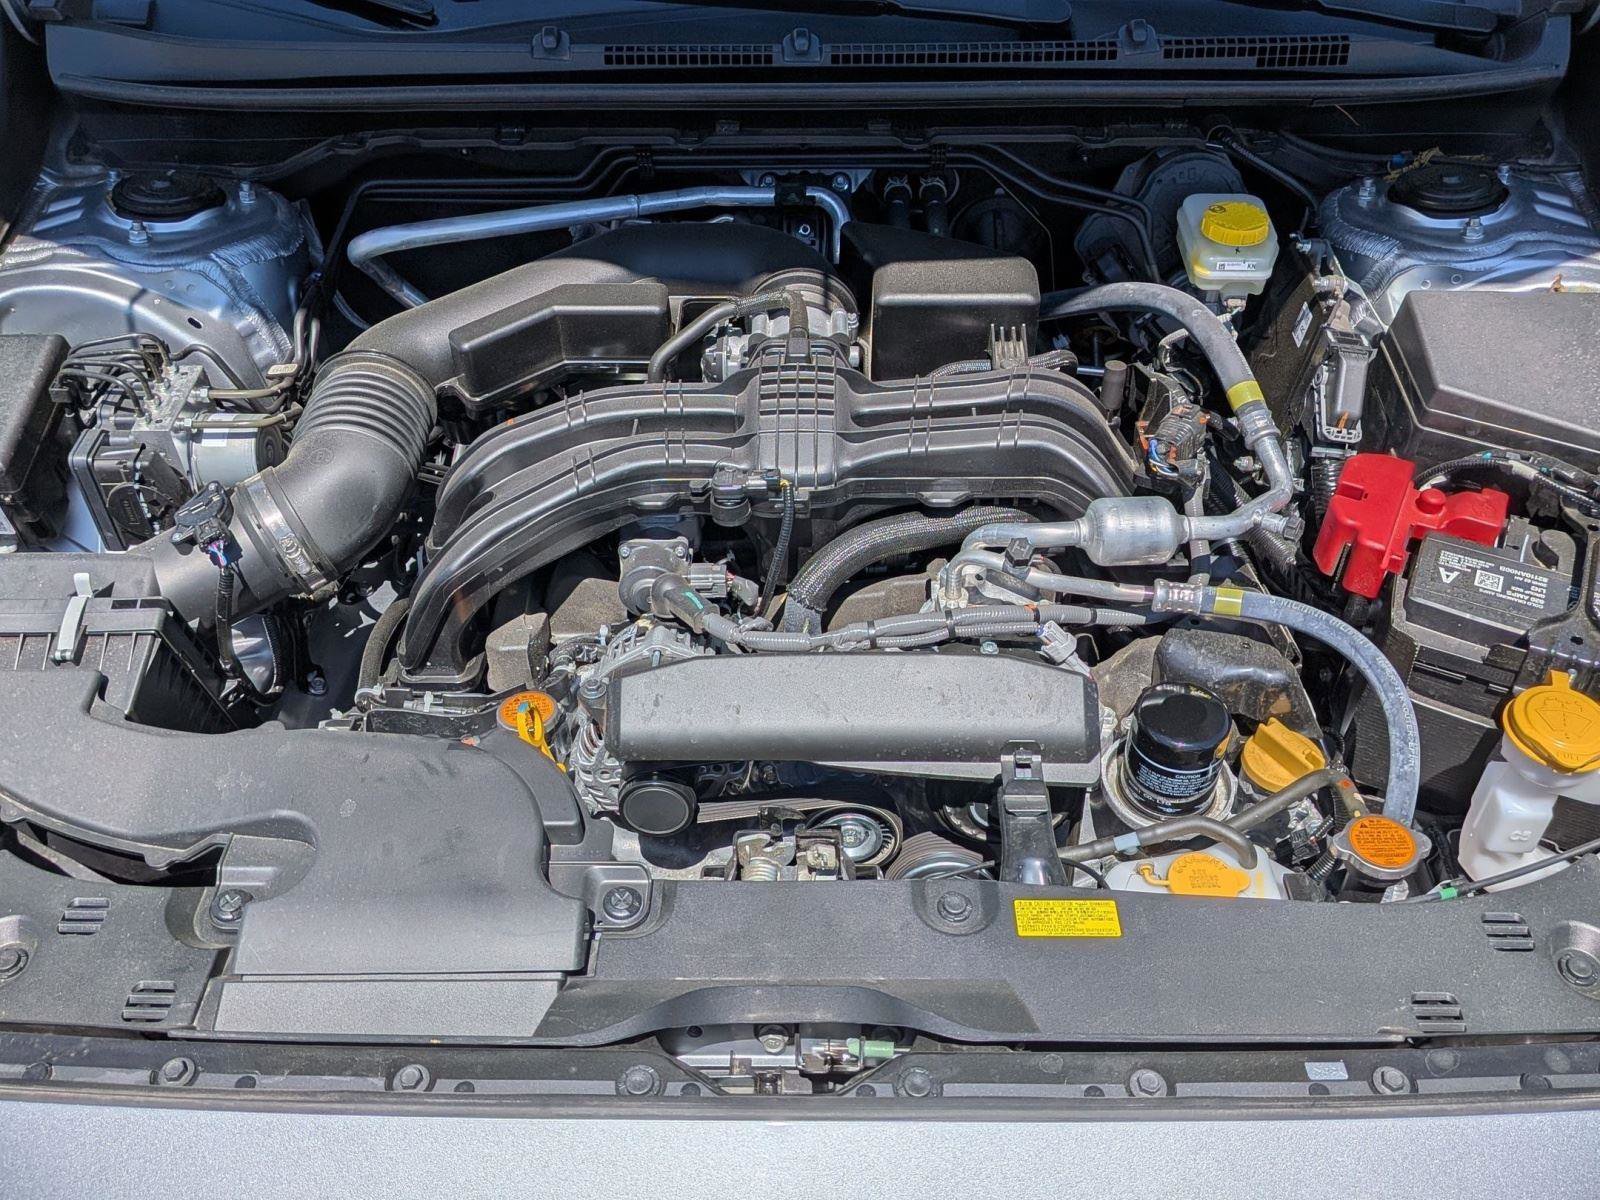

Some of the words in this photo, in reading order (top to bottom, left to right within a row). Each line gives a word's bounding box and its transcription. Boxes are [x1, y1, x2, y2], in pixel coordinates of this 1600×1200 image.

[1439, 567, 1460, 583] A
[1496, 592, 1526, 604] CRANKING
[1506, 590, 1529, 600] AMPS
[1525, 589, 1545, 599] GROUP
[1527, 601, 1544, 609] COLD
